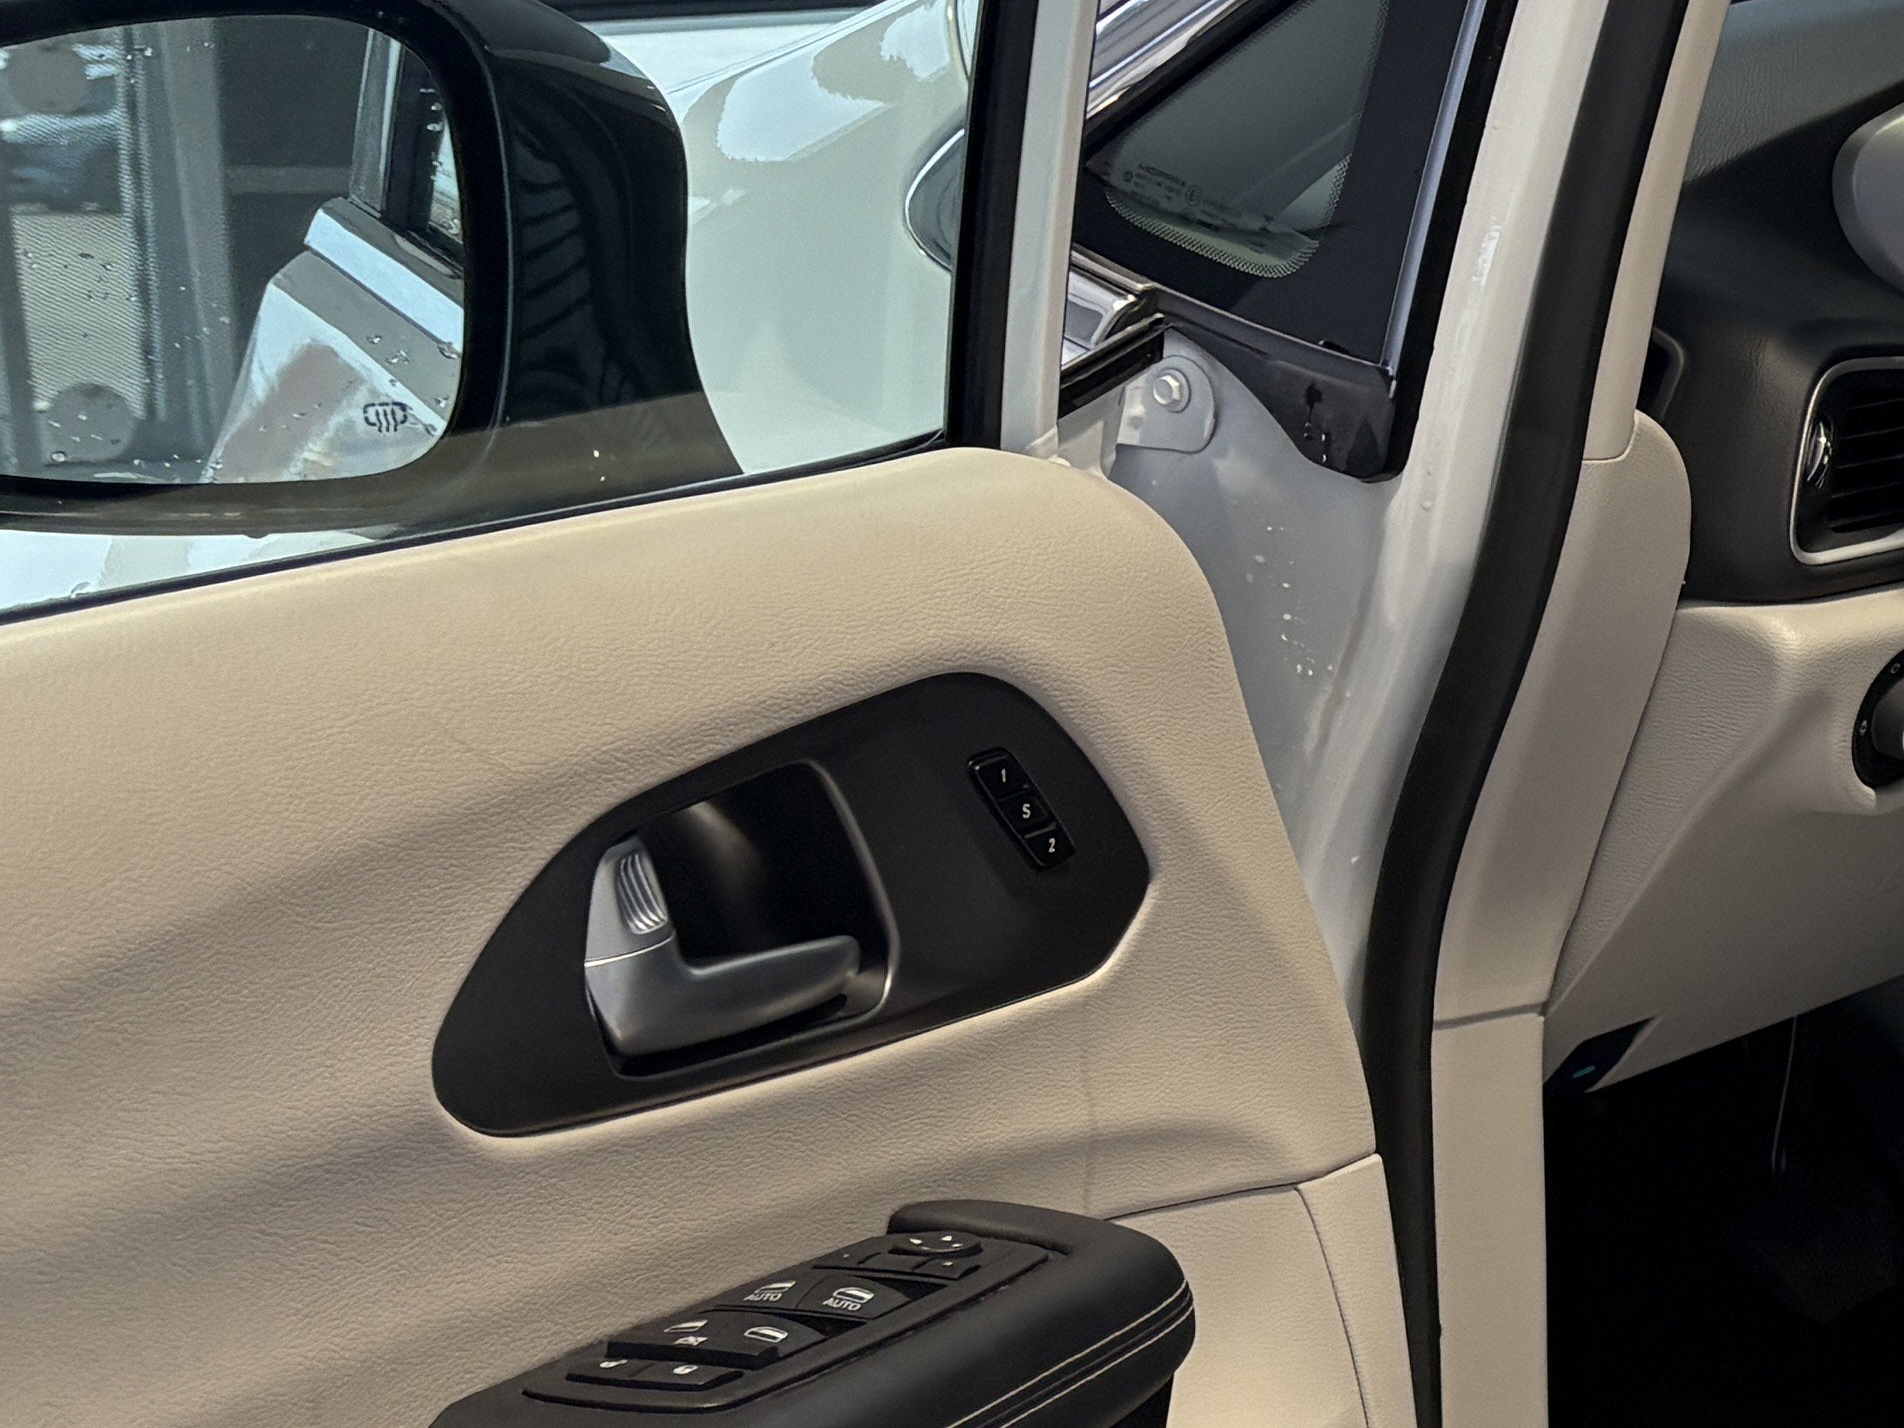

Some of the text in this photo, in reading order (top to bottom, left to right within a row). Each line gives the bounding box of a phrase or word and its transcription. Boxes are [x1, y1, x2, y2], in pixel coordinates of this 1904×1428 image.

[1001, 768, 1007, 783] 1
[1022, 803, 1031, 819] S
[1048, 837, 1056, 853] 2
[743, 1292, 783, 1302] AUTO
[822, 1297, 862, 1311] AUTO
